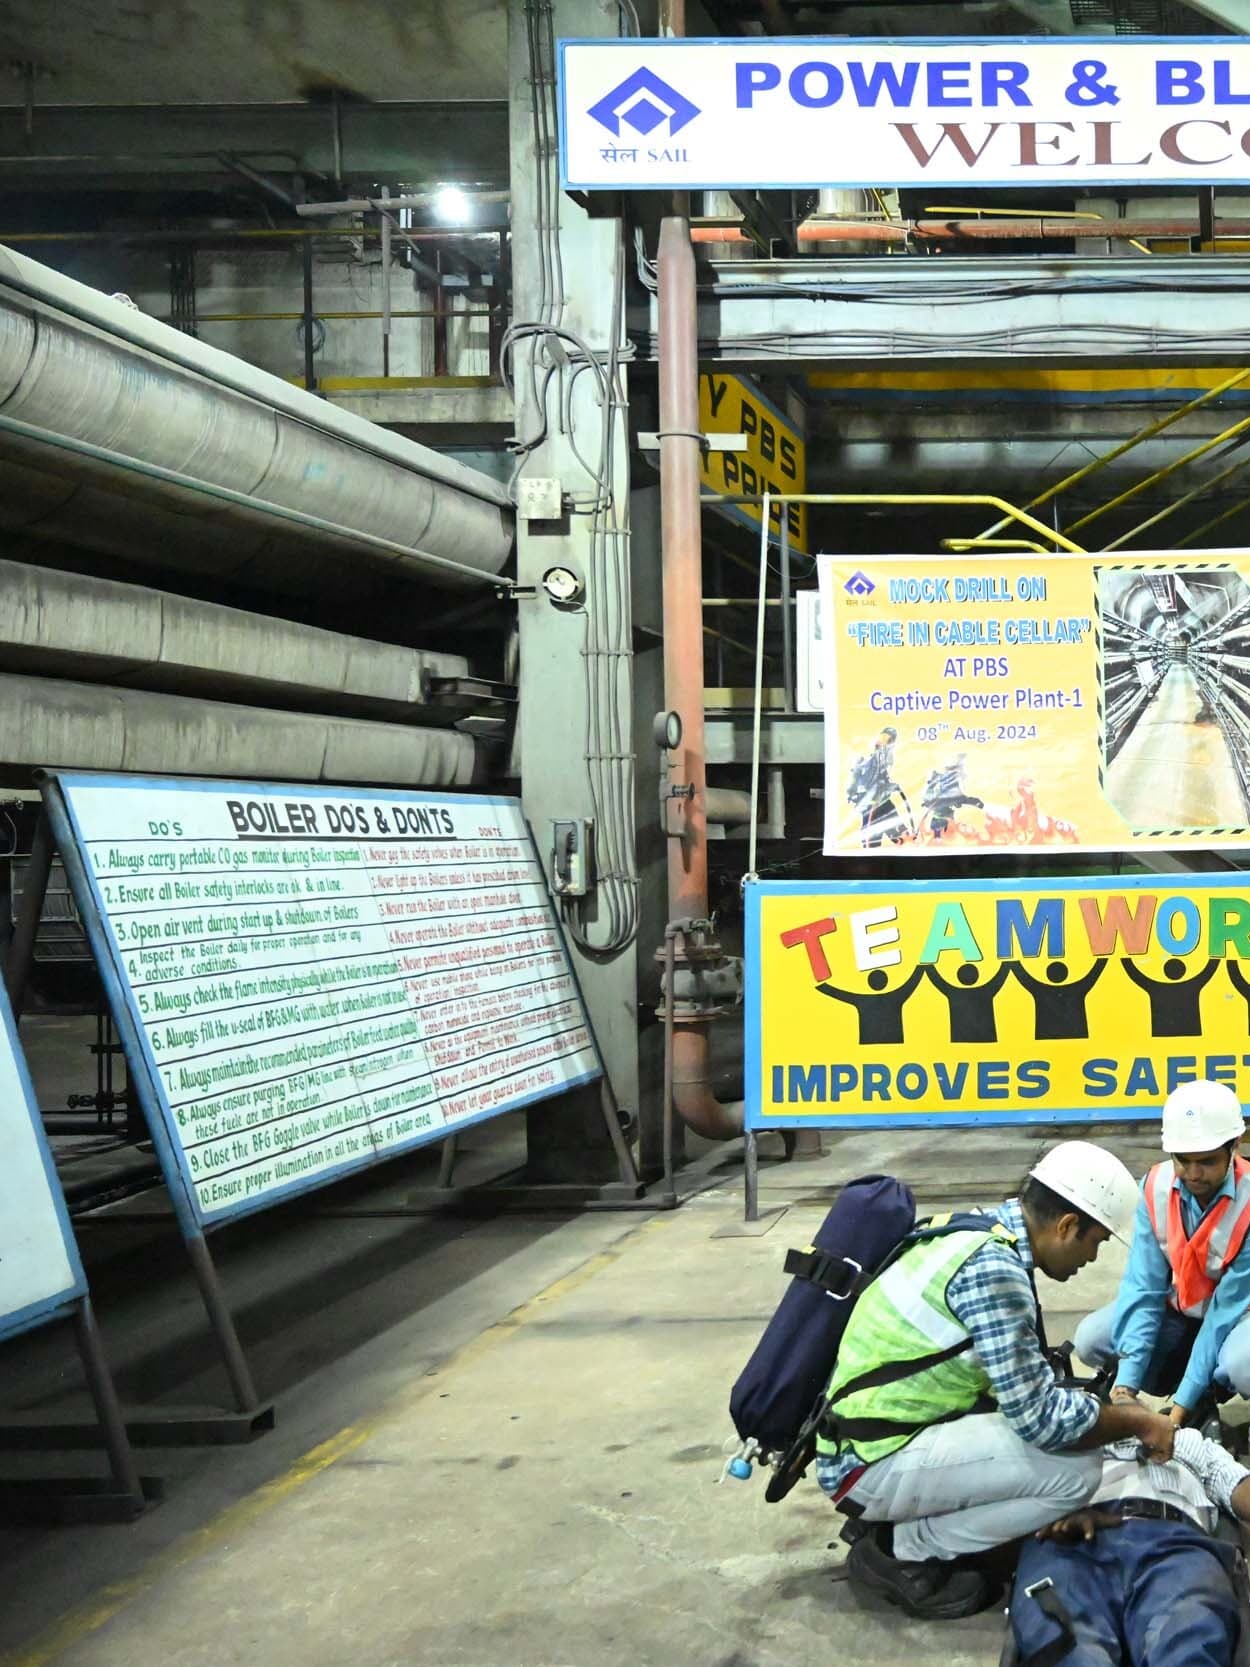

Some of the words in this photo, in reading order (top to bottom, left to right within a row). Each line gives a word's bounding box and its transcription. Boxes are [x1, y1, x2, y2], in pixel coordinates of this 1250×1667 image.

[735, 61, 1031, 108] POWER
[1065, 59, 1121, 106] &
[647, 149, 694, 163] SAIL
[740, 399, 796, 481] PBS
[889, 576, 949, 603] MOCK
[954, 576, 1013, 602] DRILL
[1016, 575, 1047, 601] ON
[908, 620, 930, 646] IN
[934, 619, 1000, 646] CABLE
[943, 658, 967, 677] AT
[973, 657, 1009, 676] PBS
[870, 691, 942, 715] Captive
[949, 690, 1009, 709] Power
[1016, 688, 1083, 708] Plant-1
[954, 727, 991, 743] Aug.
[996, 725, 1037, 740] 2024
[226, 801, 319, 834] BOILER
[374, 806, 391, 834] &
[108, 848, 145, 873] Always
[148, 853, 176, 871] carry
[179, 847, 216, 870] portable
[218, 847, 230, 864] CO
[233, 850, 249, 870] gas
[282, 848, 311, 868] during
[158, 881, 172, 900] all
[174, 881, 200, 900] Boiler
[204, 880, 233, 901] safety
[233, 879, 275, 897] interlocks
[164, 918, 180, 937] air
[182, 915, 204, 935] vent
[207, 913, 239, 936] during
[240, 911, 261, 928] start
[262, 914, 274, 933] up
[275, 909, 284, 926] &
[323, 909, 332, 923] of
[333, 905, 359, 921] Boilers
[140, 947, 174, 968] Inspect
[181, 943, 195, 959] the
[200, 943, 223, 957] Boiler
[227, 939, 248, 957] daily
[250, 937, 261, 952] for
[262, 938, 285, 952] proper
[145, 966, 184, 981] adverse
[154, 991, 192, 1014] Always
[193, 984, 218, 1005] check
[219, 981, 234, 999] the
[234, 979, 258, 1001] flame
[165, 1027, 200, 1049] Always
[200, 1020, 215, 1043] fill
[215, 1019, 229, 1038] the
[231, 1012, 256, 1034] u-seal
[179, 1067, 212, 1093] Always
[771, 1059, 1052, 1103] IMPROVES
[222, 1092, 252, 1111] ensure
[252, 1082, 286, 1106] purging
[195, 1123, 218, 1139] these
[246, 1108, 259, 1125] are
[262, 1105, 274, 1119] not
[203, 1145, 233, 1169] Close
[232, 1139, 249, 1161] the
[252, 1130, 271, 1153] BFG
[245, 1169, 273, 1194] proper
[274, 1147, 324, 1179] illumination
